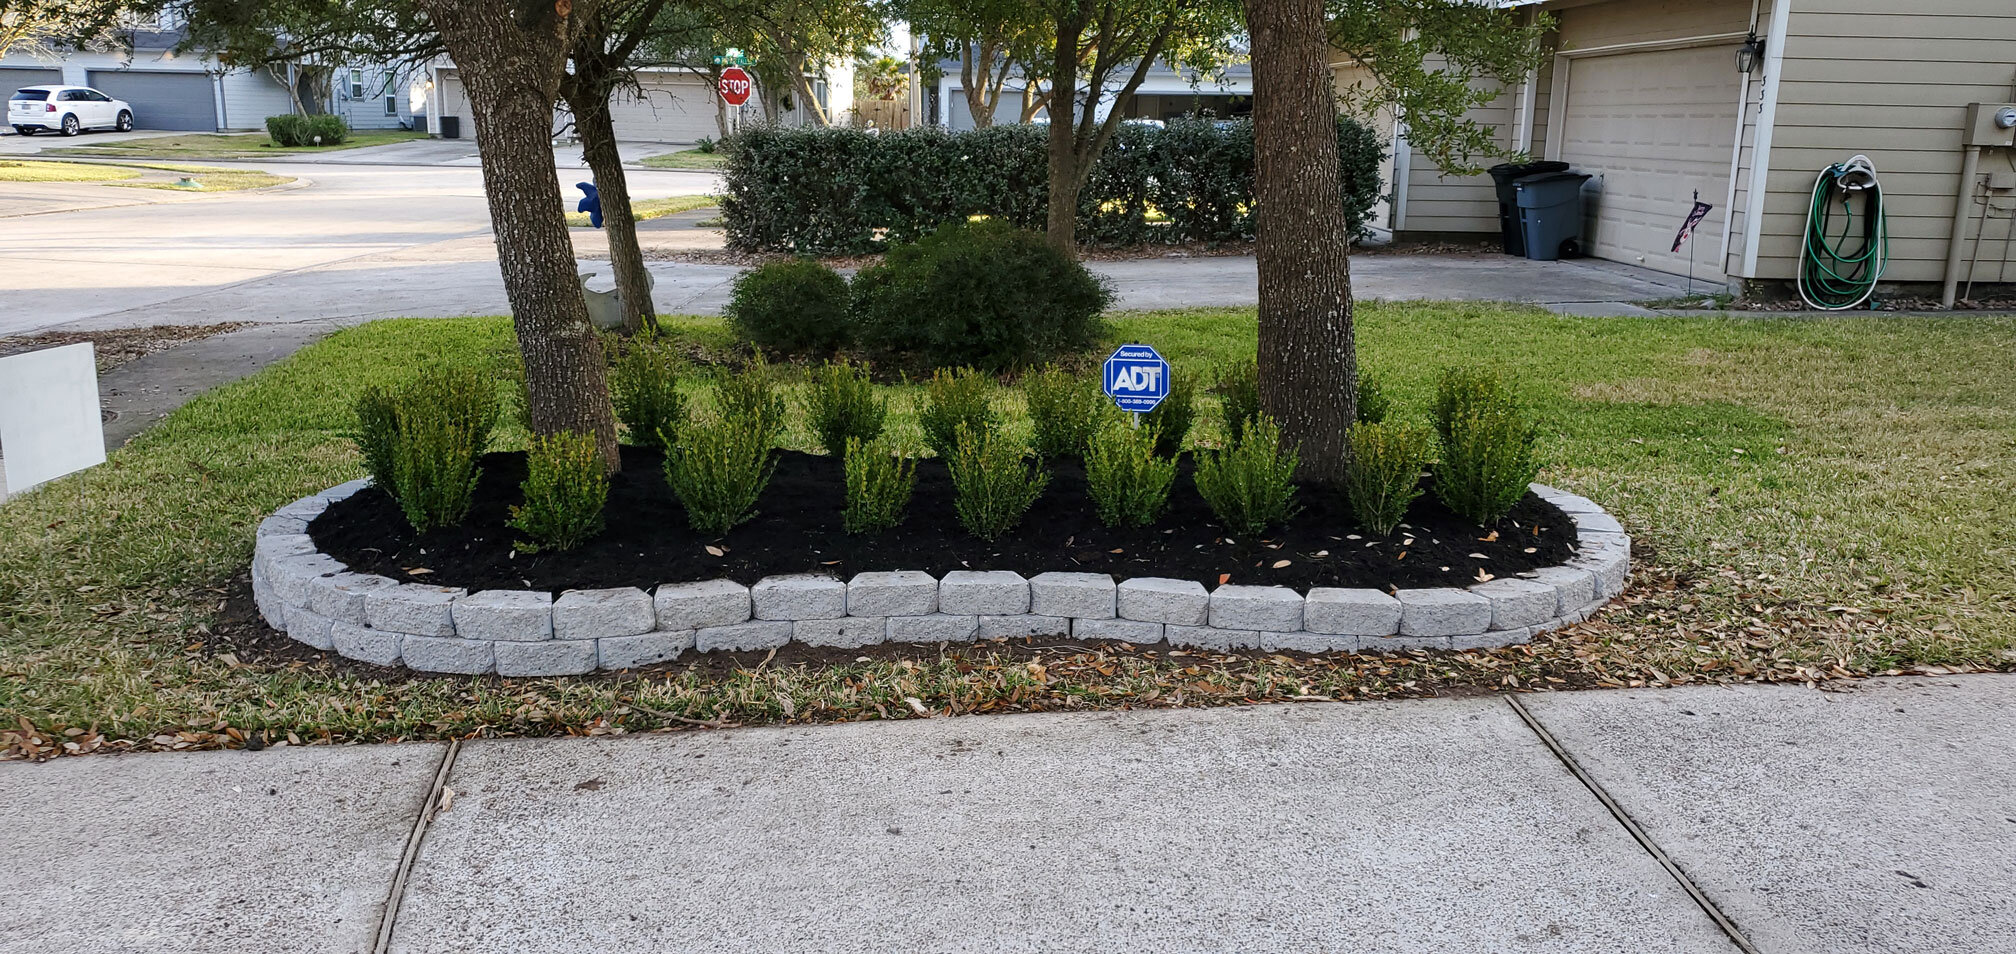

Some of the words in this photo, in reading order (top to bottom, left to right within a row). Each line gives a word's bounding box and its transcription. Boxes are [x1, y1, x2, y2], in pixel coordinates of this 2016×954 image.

[721, 79, 749, 94] STOP
[1120, 350, 1144, 358] Secured
[1145, 351, 1153, 359] by
[1113, 366, 1161, 392] ADT
